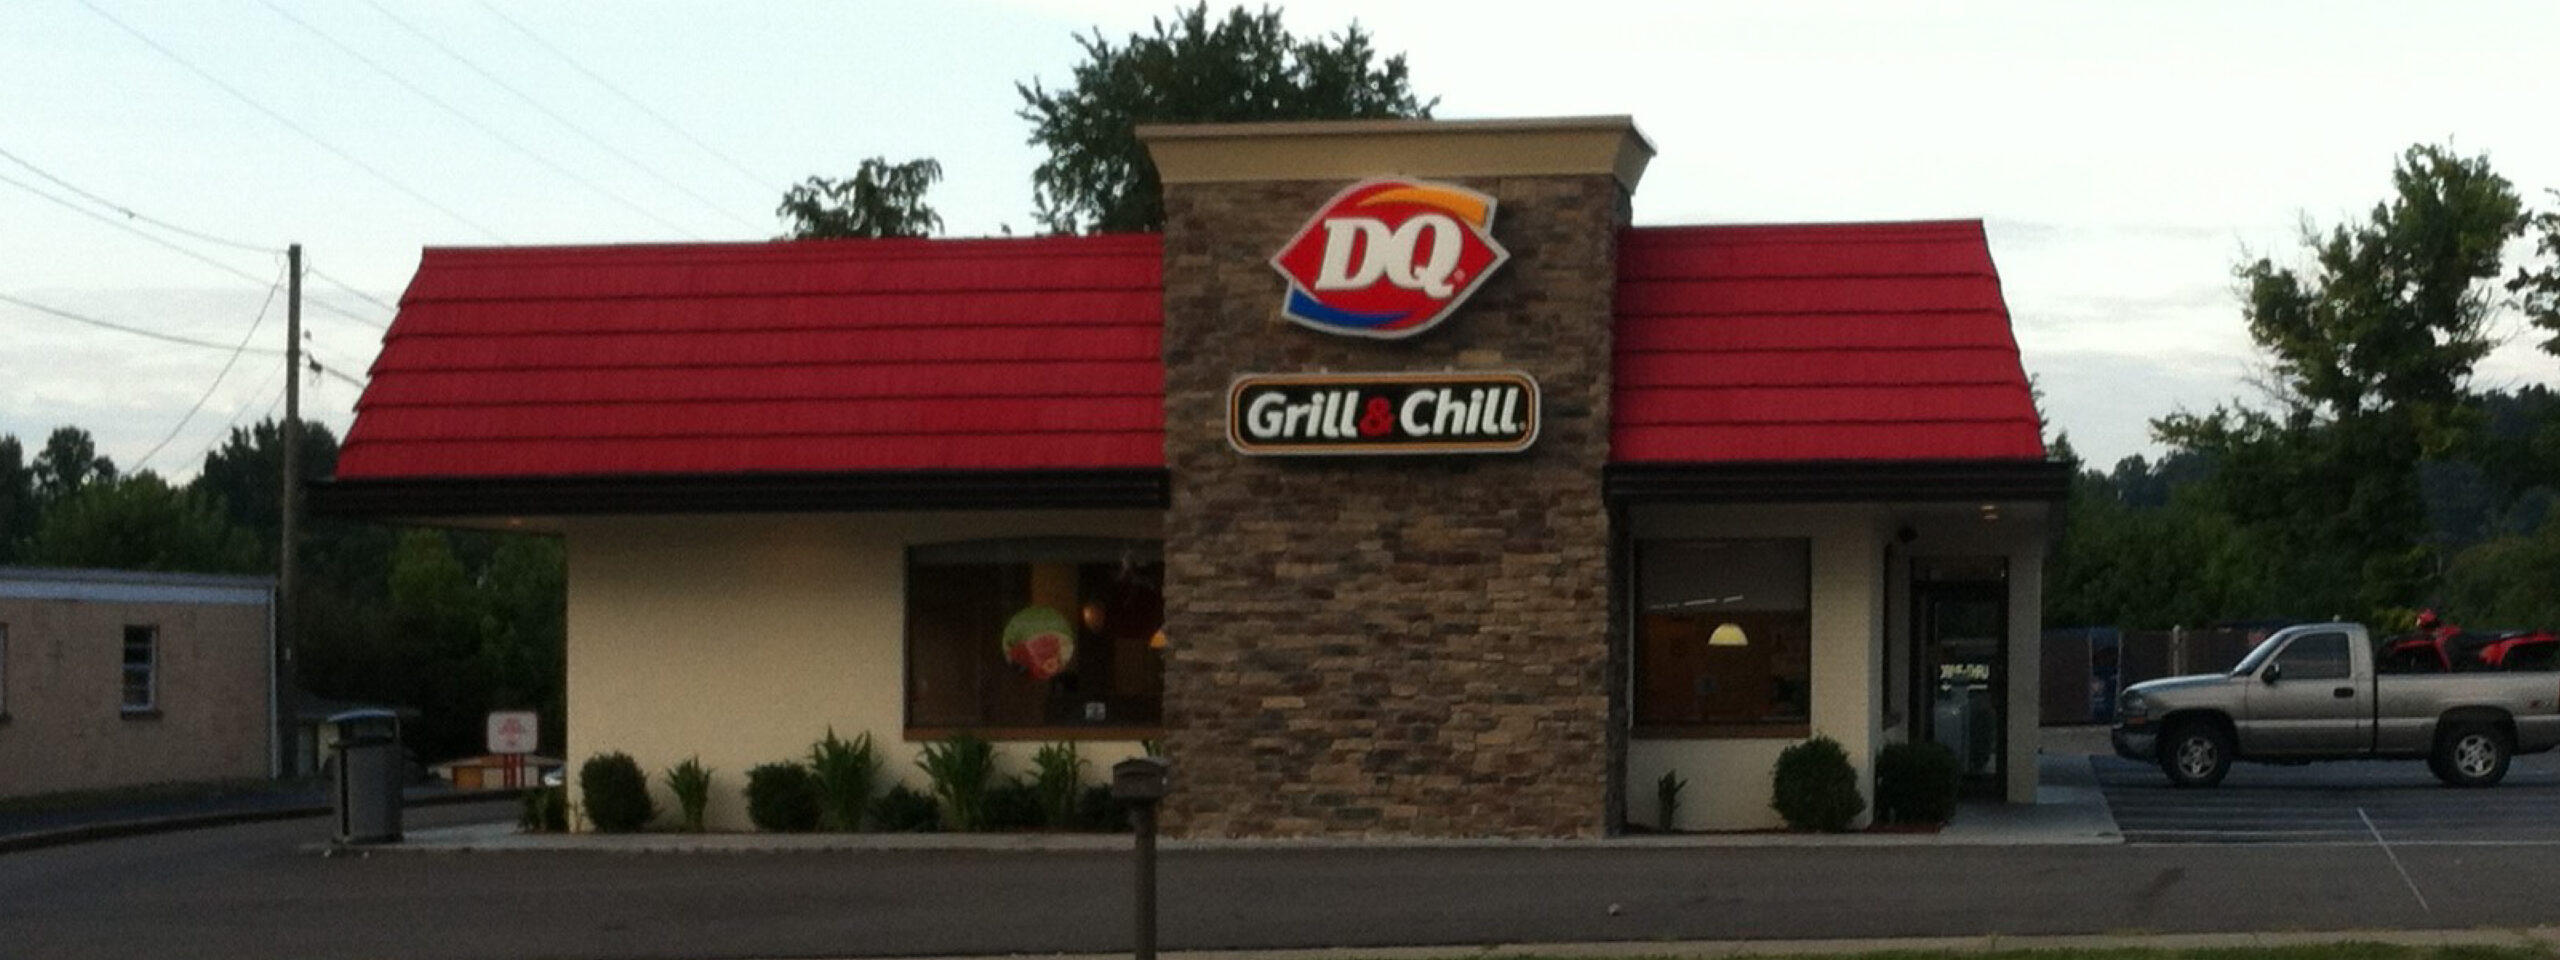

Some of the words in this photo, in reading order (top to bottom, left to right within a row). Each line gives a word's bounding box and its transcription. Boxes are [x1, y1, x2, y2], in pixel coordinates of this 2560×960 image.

[1315, 213, 1463, 299] DQ
[1247, 391, 1360, 438] Grill
[1360, 395, 1394, 436] &
[1400, 387, 1520, 436] Chill
